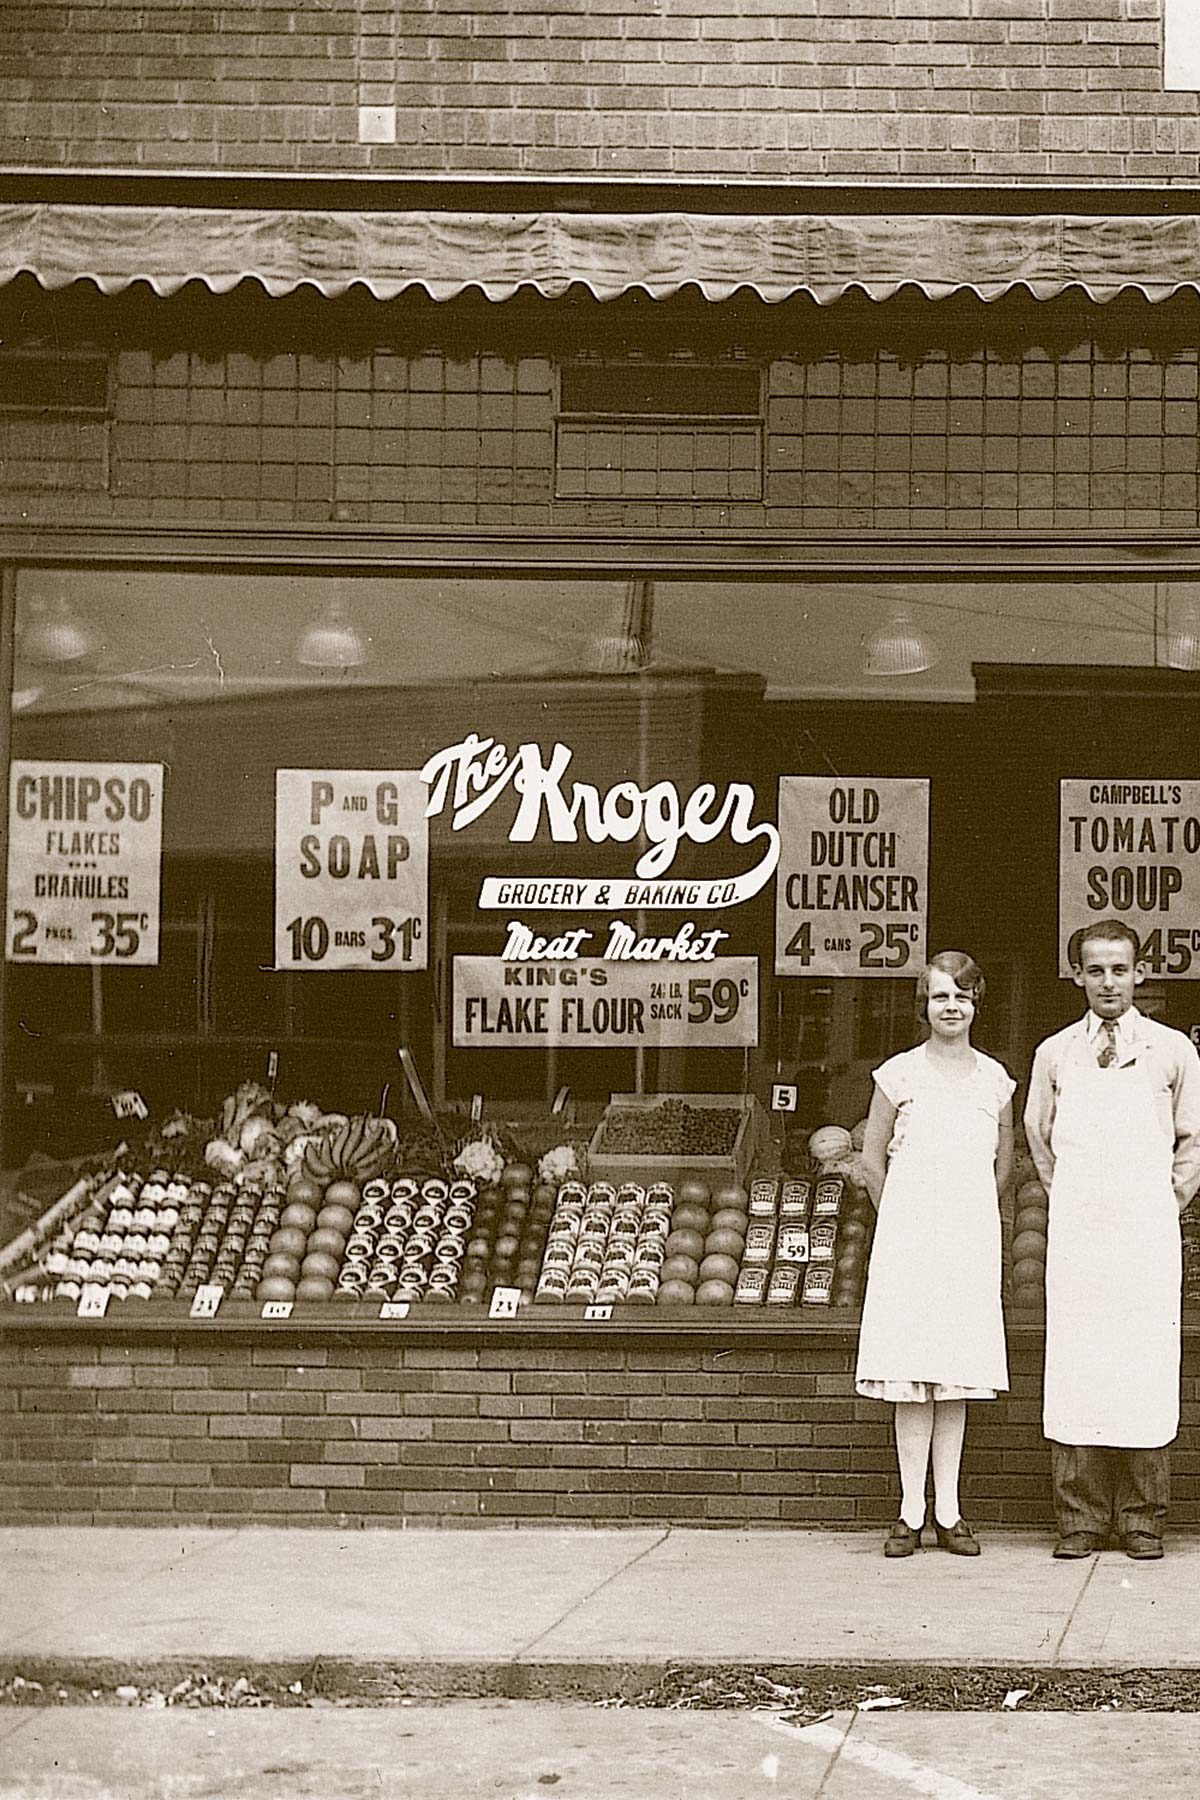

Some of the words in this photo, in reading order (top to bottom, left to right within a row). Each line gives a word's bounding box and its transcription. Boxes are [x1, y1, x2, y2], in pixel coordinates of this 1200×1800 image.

[16, 776, 151, 822] CHIPSO
[311, 782, 334, 825] P
[343, 796, 367, 812] AND
[376, 782, 399, 825] G
[420, 734, 508, 830] The
[508, 743, 781, 879] Kroger
[829, 788, 879, 824] OLD
[1089, 785, 1182, 805] CAMPBELL'S
[46, 831, 120, 855] FLAKES
[811, 831, 896, 868] DUTCH
[1069, 817, 1200, 854] TOMATO
[300, 835, 410, 880] SOAP
[35, 874, 129, 899] GRANULES
[498, 884, 588, 904] GROCERY
[594, 885, 610, 905] &
[625, 884, 701, 905] BAKING
[707, 884, 740, 903] CO.
[786, 874, 918, 912] CLEANSER
[1087, 866, 1182, 912] SOUP
[12, 909, 38, 955] 2
[287, 917, 329, 960] 10
[335, 931, 365, 946] BARS
[501, 921, 593, 961] Meat
[603, 920, 730, 962] Market
[785, 922, 815, 966] 4
[824, 937, 851, 952] CANS
[504, 968, 607, 986] KING'S
[465, 998, 548, 1033] FLAKE
[561, 998, 644, 1034] FLOUR
[650, 1004, 682, 1019] SACK
[777, 1089, 790, 1107] 5
[787, 1245, 806, 1257] 59
